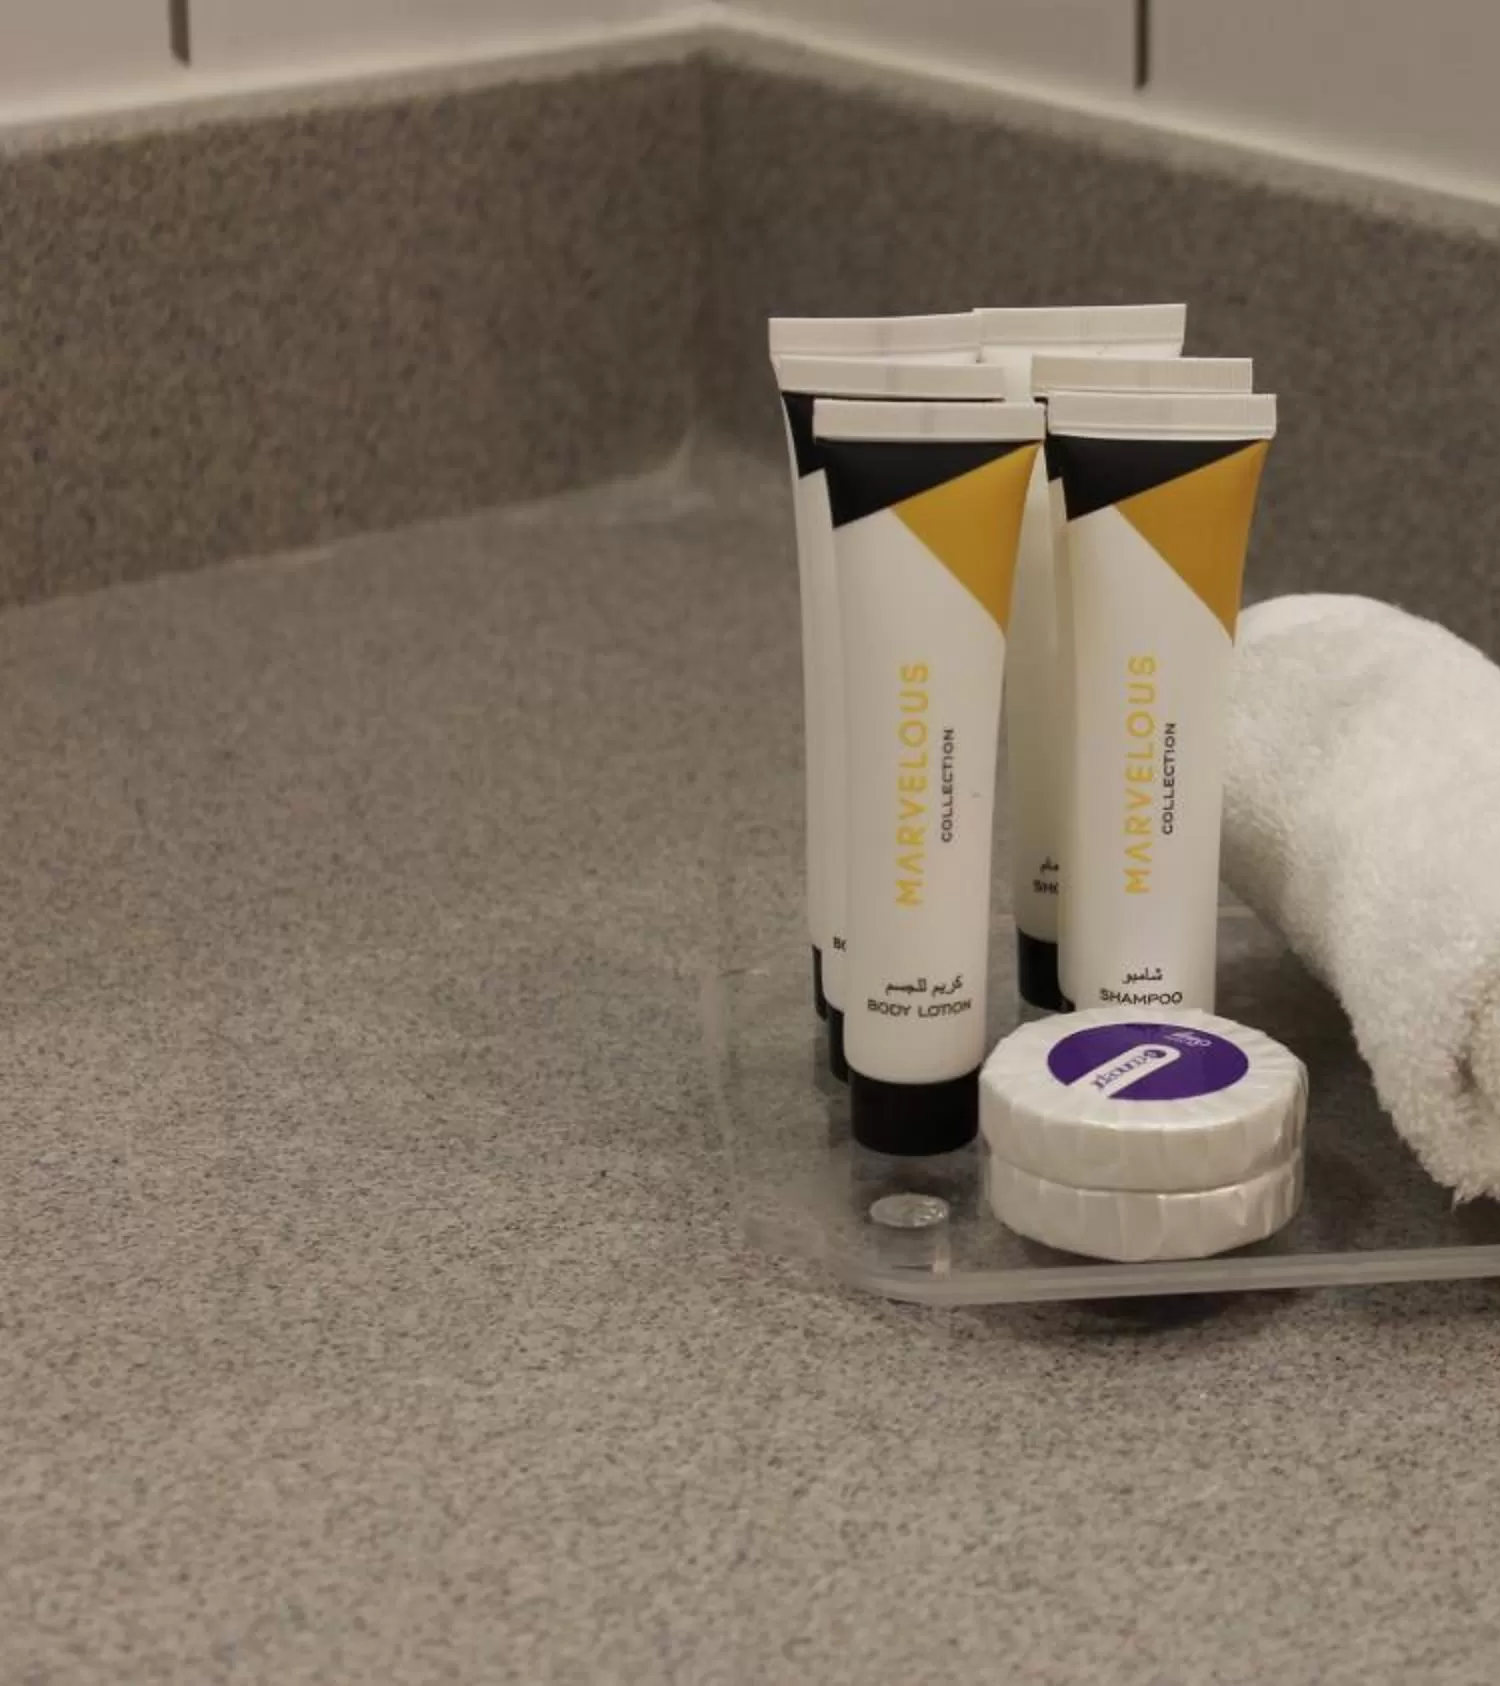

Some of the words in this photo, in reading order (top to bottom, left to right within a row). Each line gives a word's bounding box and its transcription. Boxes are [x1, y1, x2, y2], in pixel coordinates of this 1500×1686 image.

[895, 661, 929, 907] MARVELOUS
[941, 727, 955, 844] COLLECTION
[1122, 654, 1157, 895] MARVELOUS
[1162, 722, 1177, 836] COLLECTION
[867, 999, 912, 1017] BODY
[918, 998, 972, 1018] LOTION
[885, 977, 927, 997] للجسم
[932, 973, 964, 998] كريم
[1100, 987, 1183, 1006] SHAMPOO
